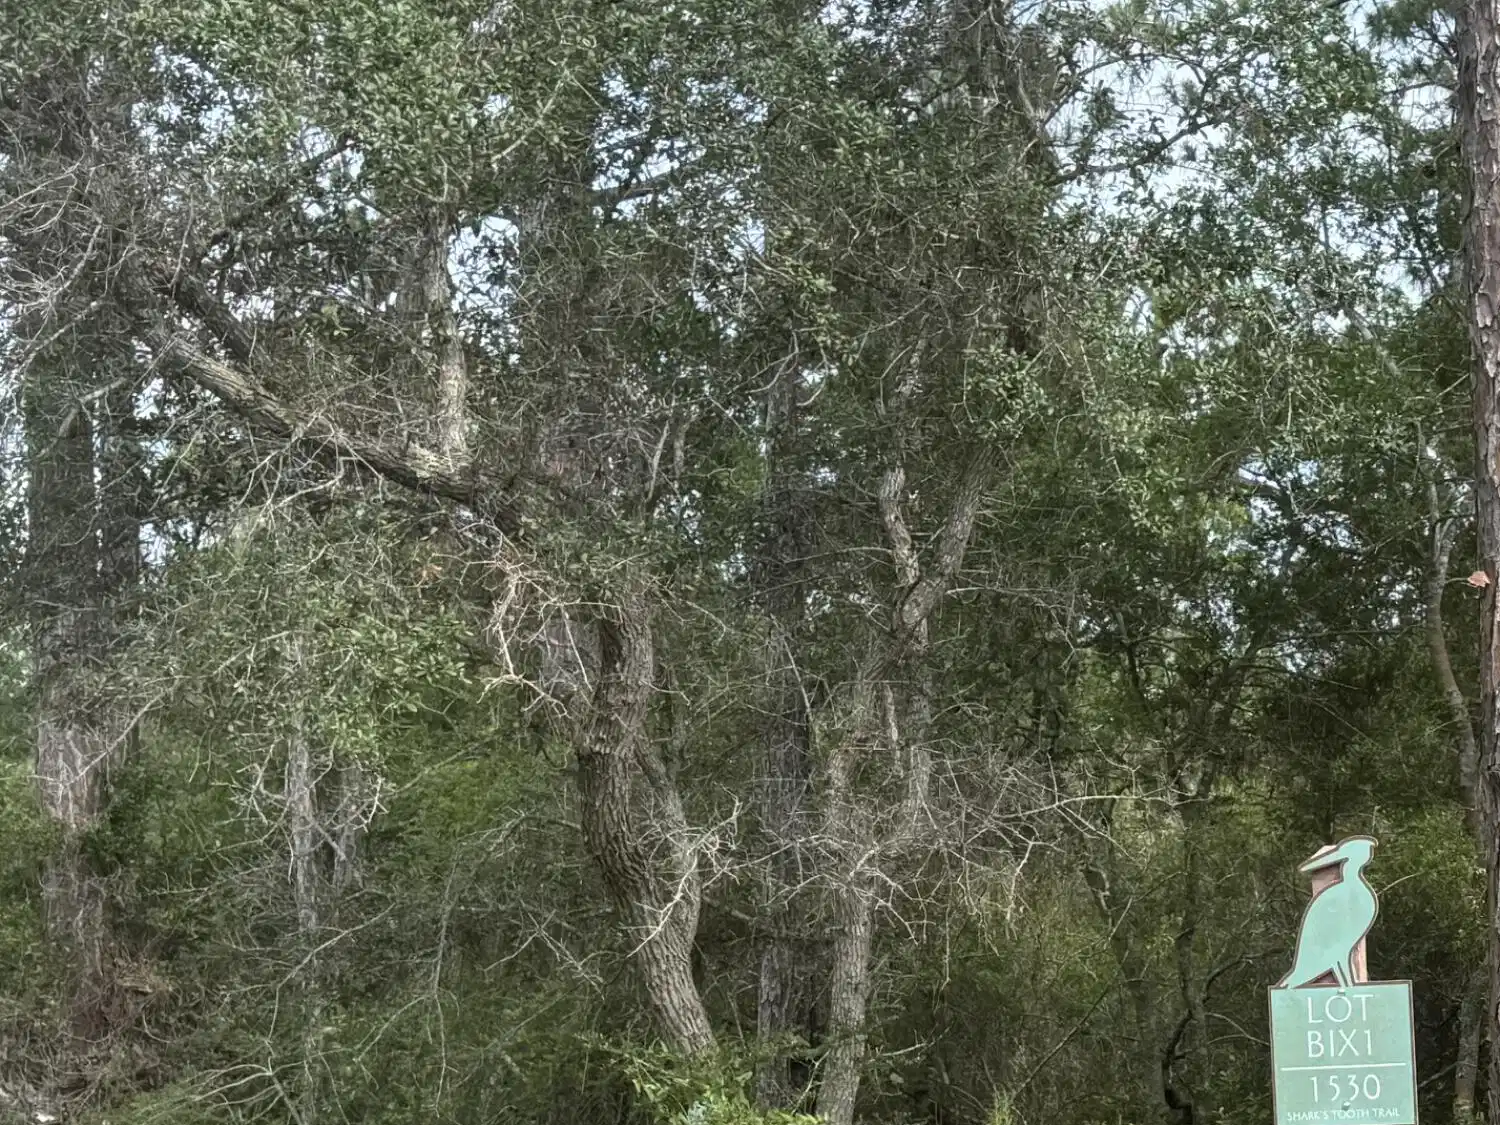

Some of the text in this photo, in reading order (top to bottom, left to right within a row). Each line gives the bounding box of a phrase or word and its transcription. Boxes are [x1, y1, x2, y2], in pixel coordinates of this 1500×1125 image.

[1307, 994, 1374, 1024] LOT
[1307, 1029, 1372, 1058] BIX1
[1310, 1074, 1381, 1103] 1530
[1287, 1107, 1400, 1122] SHARK'S TOOTH TRAIL
